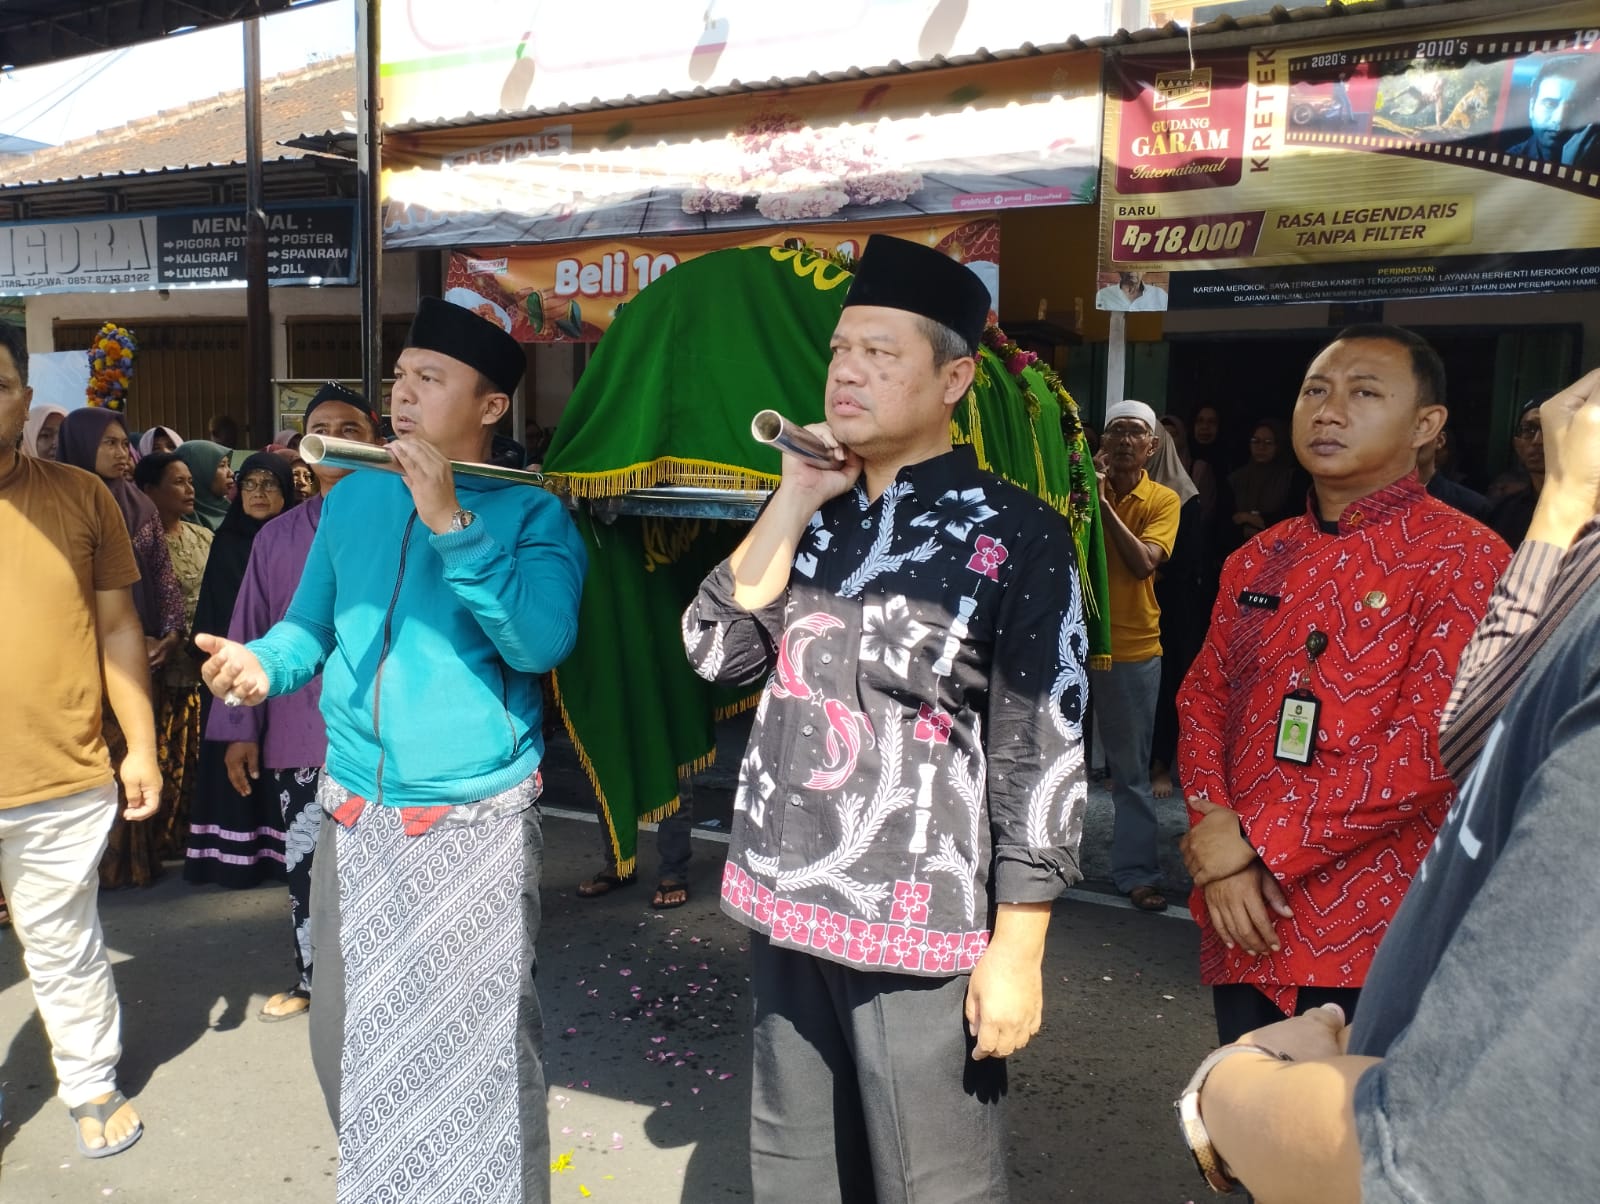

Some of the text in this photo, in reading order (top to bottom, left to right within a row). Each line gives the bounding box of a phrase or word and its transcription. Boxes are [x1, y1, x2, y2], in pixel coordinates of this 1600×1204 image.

[1415, 38, 1468, 59] 2010's
[1311, 53, 1347, 69] 2020's
[1250, 49, 1277, 173] KRETEK
[1152, 117, 1210, 133] GUDANG
[1131, 128, 1231, 157] GARAM
[1129, 157, 1228, 180] International
[1118, 205, 1156, 217] BARU
[1276, 202, 1459, 229] RASA LEGENDARIS
[192, 214, 298, 235] MENAL
[176, 236, 248, 249] PIGORA FOT
[282, 233, 334, 245] POSTER
[1296, 224, 1426, 247] TANPA FILTER
[176, 251, 238, 264] KALIGRAFI
[281, 248, 348, 260] SPANRAM
[176, 266, 229, 278] LUKISAN
[281, 263, 305, 274] DLL
[554, 250, 628, 297] Beli
[1378, 266, 1437, 276] PERINGATAN:
[1193, 286, 1225, 294] KARENA
[1330, 278, 1365, 287] KANKER
[1439, 273, 1480, 282] LAYANAN
[1481, 270, 1528, 280] BERHENTI
[1530, 267, 1578, 277] MEROKOK
[1429, 285, 1458, 293] BAWAH
[1458, 284, 1468, 292] 21
[1470, 282, 1498, 292] TAHUN
[1499, 281, 1517, 290] DAN
[1518, 279, 1571, 289] PEREMPUAN
[1572, 277, 1598, 286] HAMIL
